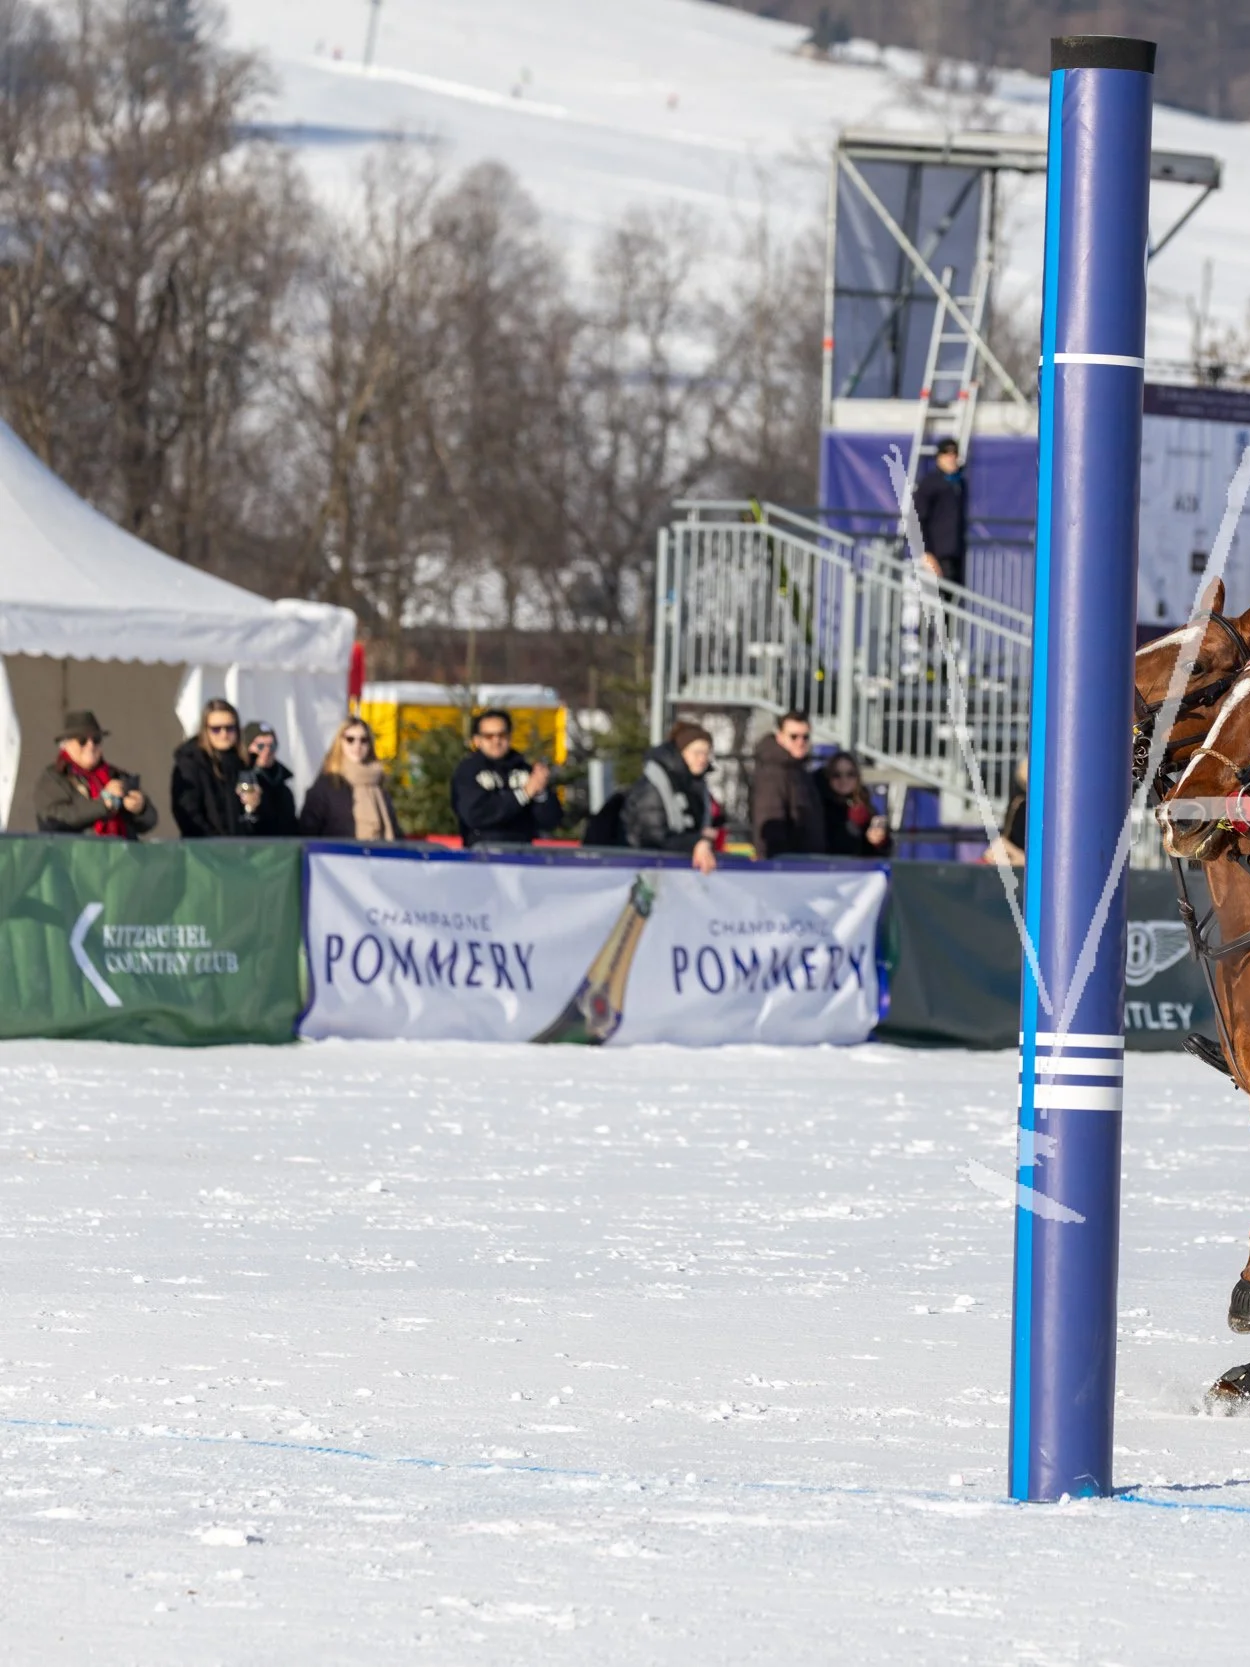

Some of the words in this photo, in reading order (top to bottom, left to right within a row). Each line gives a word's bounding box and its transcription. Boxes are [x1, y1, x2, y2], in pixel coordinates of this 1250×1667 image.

[366, 907, 493, 932] CHAMPAGNE
[326, 933, 536, 992] POMMERY
[671, 945, 867, 995] POMMERY
